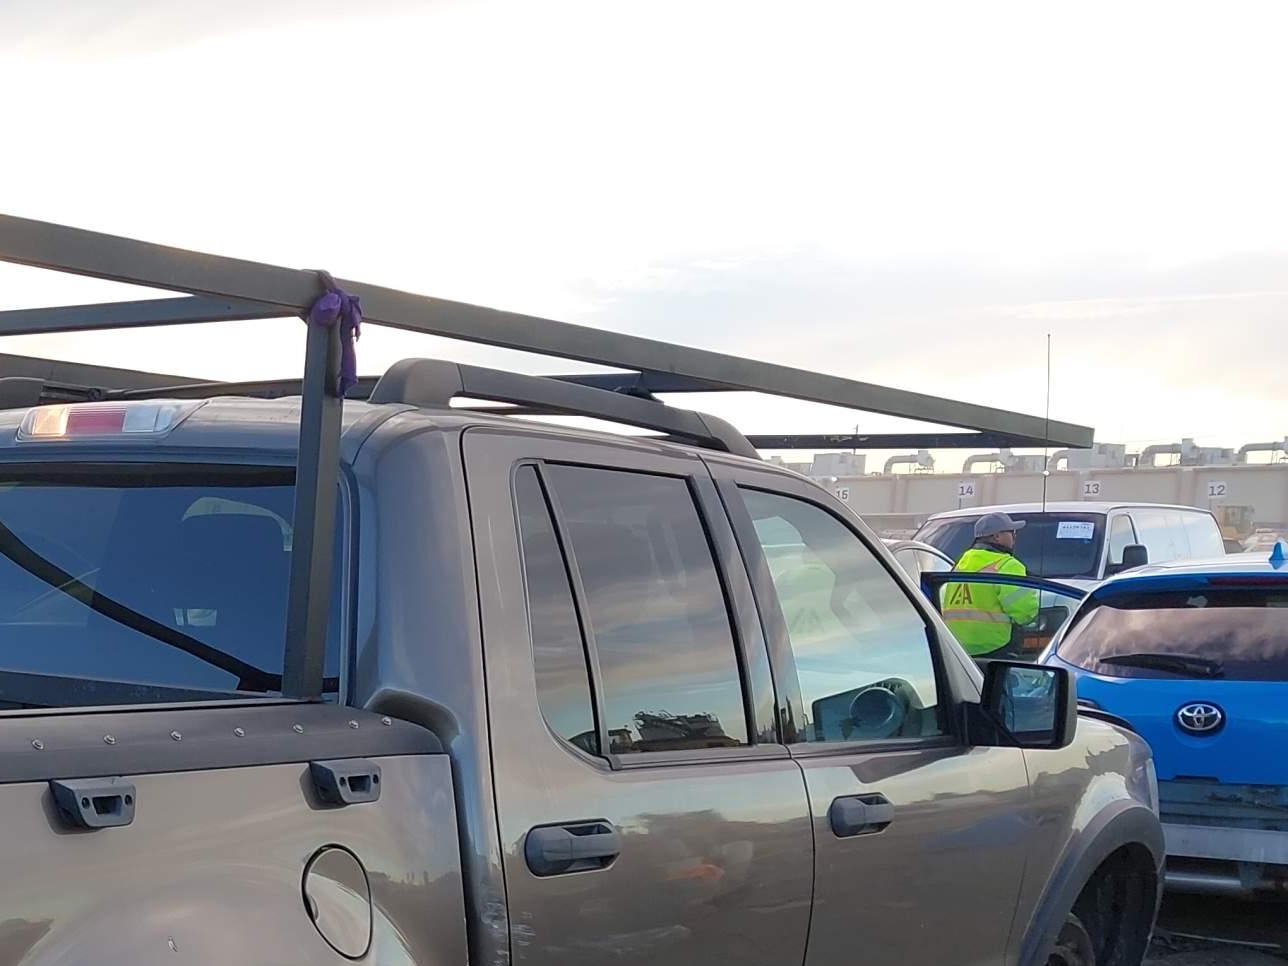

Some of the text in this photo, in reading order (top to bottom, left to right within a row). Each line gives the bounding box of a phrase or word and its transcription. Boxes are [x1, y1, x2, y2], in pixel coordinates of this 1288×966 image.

[959, 484, 974, 496] 14
[1085, 483, 1100, 494] 13
[1208, 484, 1225, 496] 12
